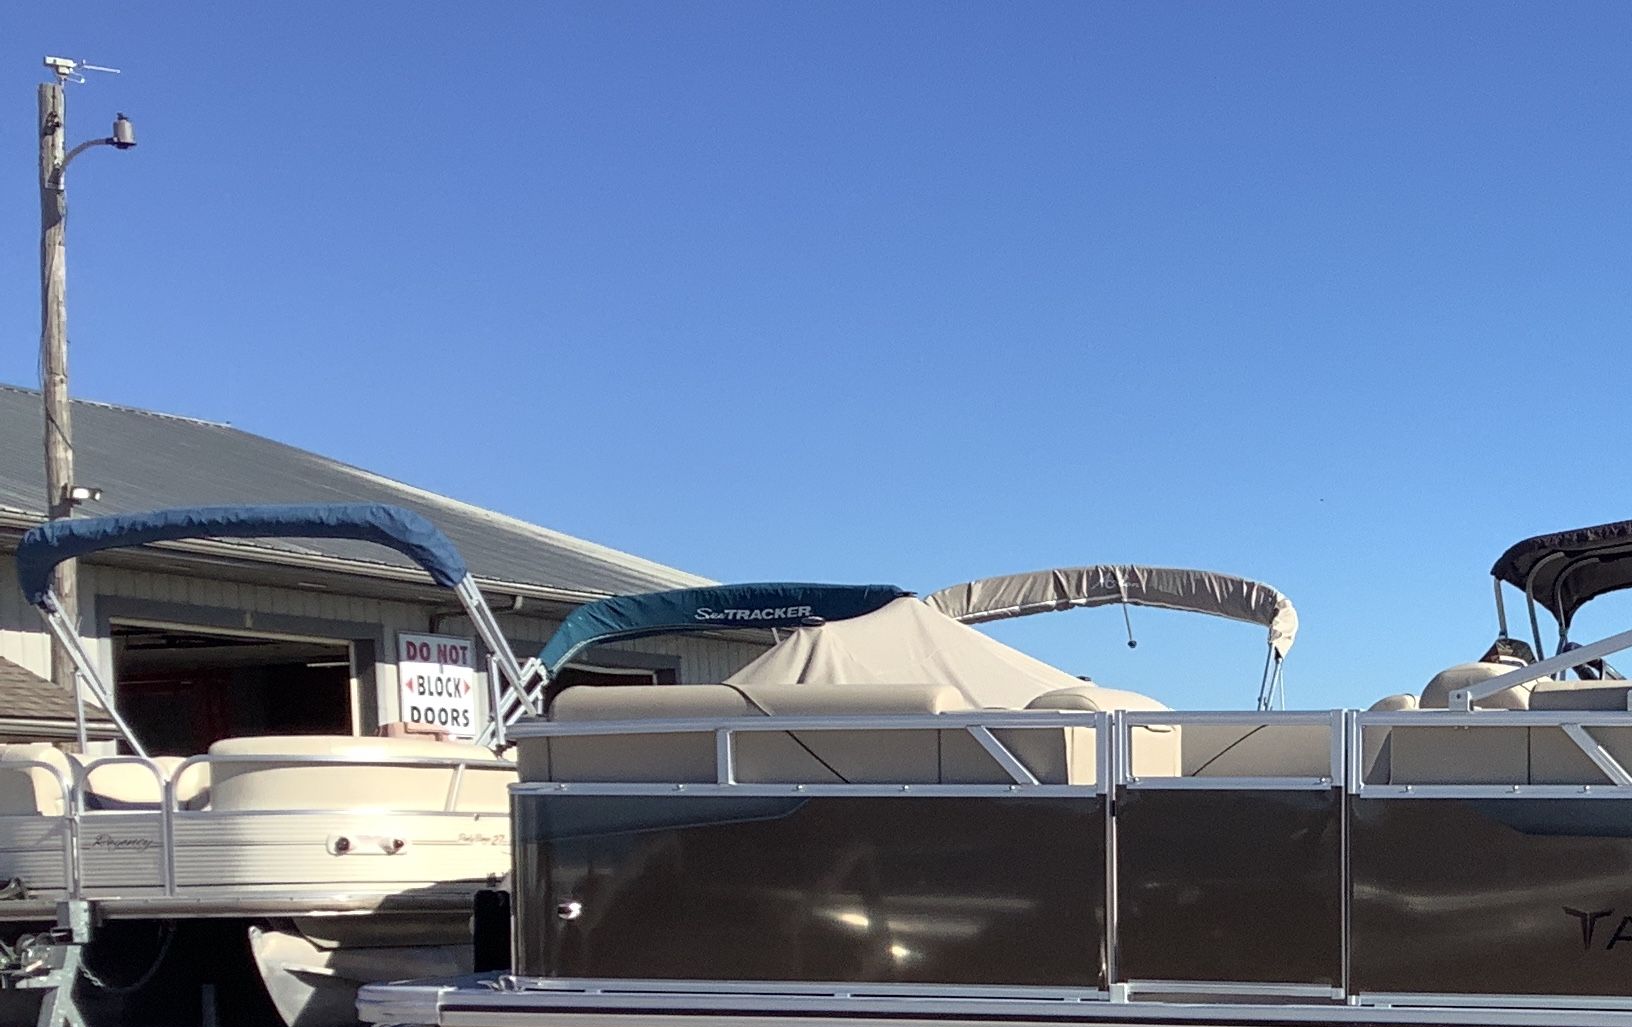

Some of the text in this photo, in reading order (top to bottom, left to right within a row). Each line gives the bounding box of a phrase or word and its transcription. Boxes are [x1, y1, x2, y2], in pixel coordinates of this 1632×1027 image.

[405, 640, 469, 665] DO NOT
[417, 675, 462, 698] BLOCK
[410, 705, 470, 727] DOORS
